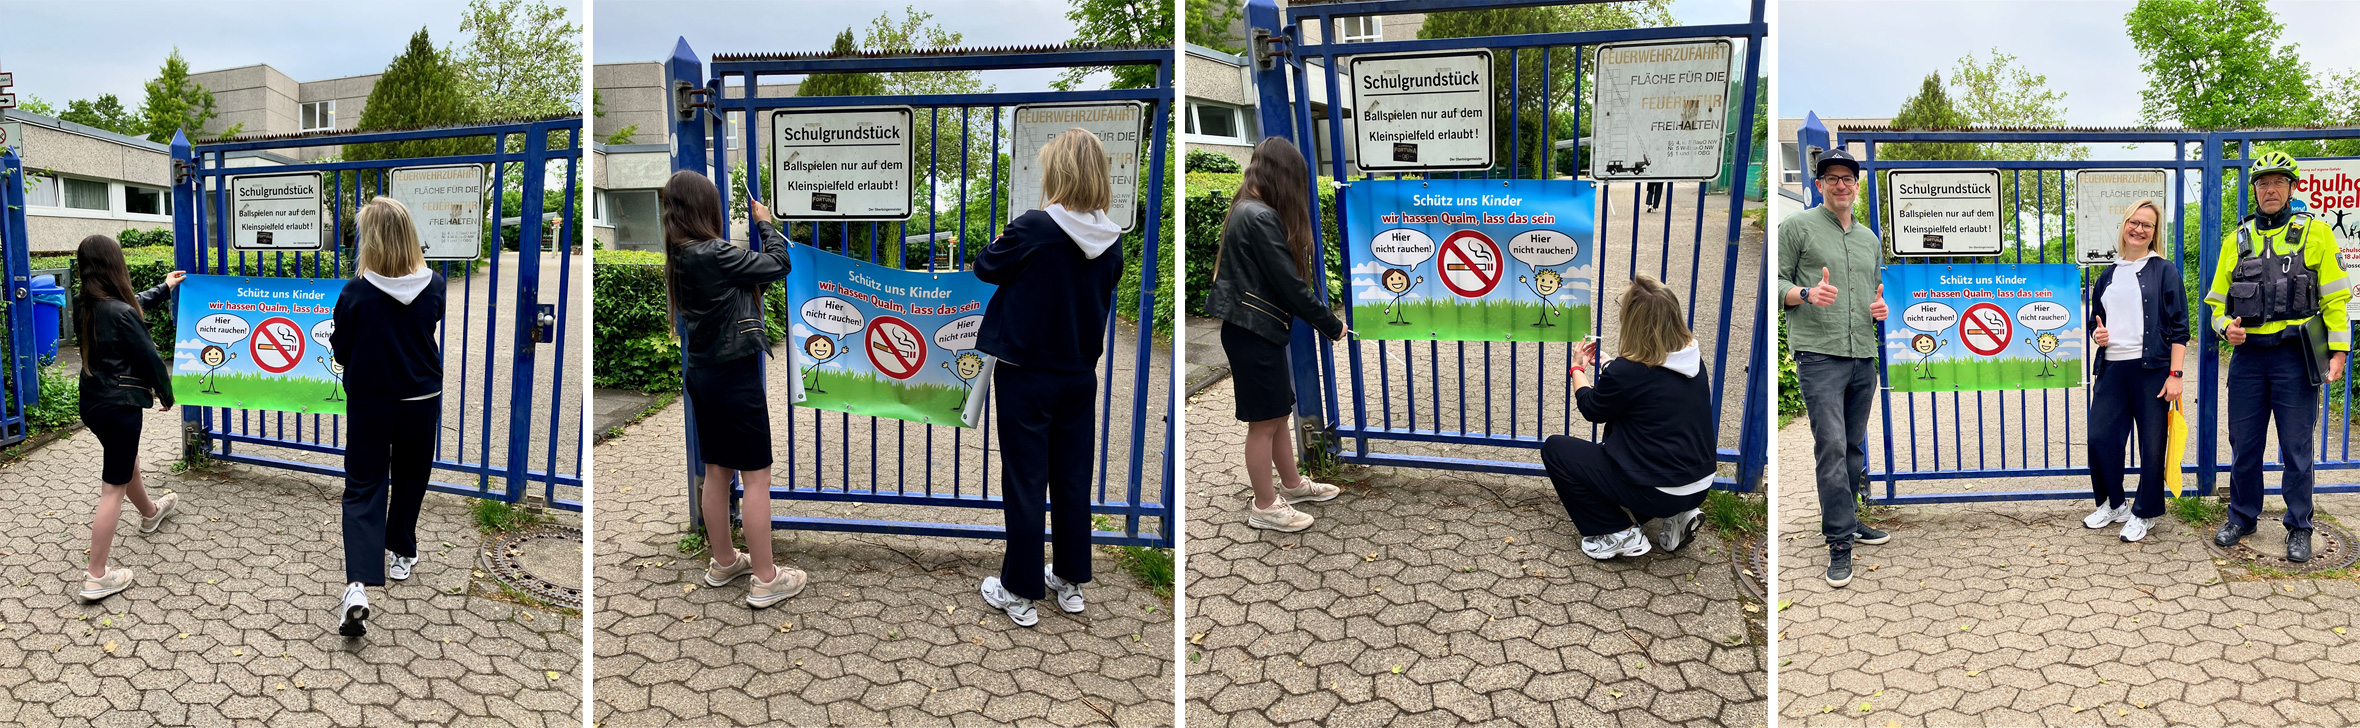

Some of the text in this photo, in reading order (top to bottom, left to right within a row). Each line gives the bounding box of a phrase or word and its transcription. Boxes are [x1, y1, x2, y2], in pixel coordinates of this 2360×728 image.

[1602, 45, 1727, 64] FEUERWEHRZUFAHRT
[1364, 71, 1479, 91] Schulgrundstück
[1631, 71, 1724, 85] FLÄCHE FÜR DIE
[1642, 94, 1722, 110] FEUERWEHR
[1019, 107, 1137, 123] FEUERWEHRZUFAHRT
[1364, 108, 1482, 123] Ballspielen nur auf dem
[1651, 120, 1720, 131] FREIHALTEN
[785, 126, 900, 143] Schulgrundstück
[1118, 132, 1135, 141] DIE
[1370, 130, 1434, 142] Kleinspielfeld
[784, 161, 837, 172] Ballspielen
[861, 160, 877, 170] auf
[881, 160, 902, 170] dem
[395, 169, 479, 181] FEUERWEHRZUFAHRT
[2080, 174, 2163, 183] FEUERWEHRZUFAHRT
[788, 181, 854, 192] Kleinspielfeld
[2297, 174, 2360, 192] chulho
[240, 185, 313, 198] Schulgrundstück
[1900, 184, 1991, 196] Schulgrundstück
[2133, 189, 2148, 197] FÜR
[423, 201, 477, 210] FEUERWEHR
[1413, 194, 1522, 206] Schütz uns Kinder
[1381, 212, 1555, 225] wir hassen Qualm, lass das sein
[1900, 210, 1942, 219] Ballspielen
[1904, 226, 1956, 234] Kleinspielfeld
[1392, 233, 1410, 241] Hier
[1531, 235, 1551, 243] Hier
[1375, 243, 1431, 253] nicht rauchen!
[1514, 245, 1573, 254] nicht rauchen!
[848, 270, 952, 299] Schütz uns Kinder
[1940, 275, 1972, 285] Schütz
[1996, 275, 2026, 285] Kinder
[237, 288, 325, 300] Schütz uns Kinder
[819, 280, 980, 315] wir hassen Qualm, lass das sein
[1913, 288, 2052, 299] wir hassen Qualm, lass das sein
[209, 301, 223, 309] wir
[226, 301, 255, 311] hassen
[259, 303, 290, 313] Qualm,
[293, 304, 310, 313] lass
[313, 305, 329, 314] das
[825, 300, 844, 311] Hier
[806, 310, 862, 326] nicht rauchen!
[200, 324, 216, 333] nicht
[957, 320, 975, 329] Hier
[939, 331, 978, 343] nicht rauc
